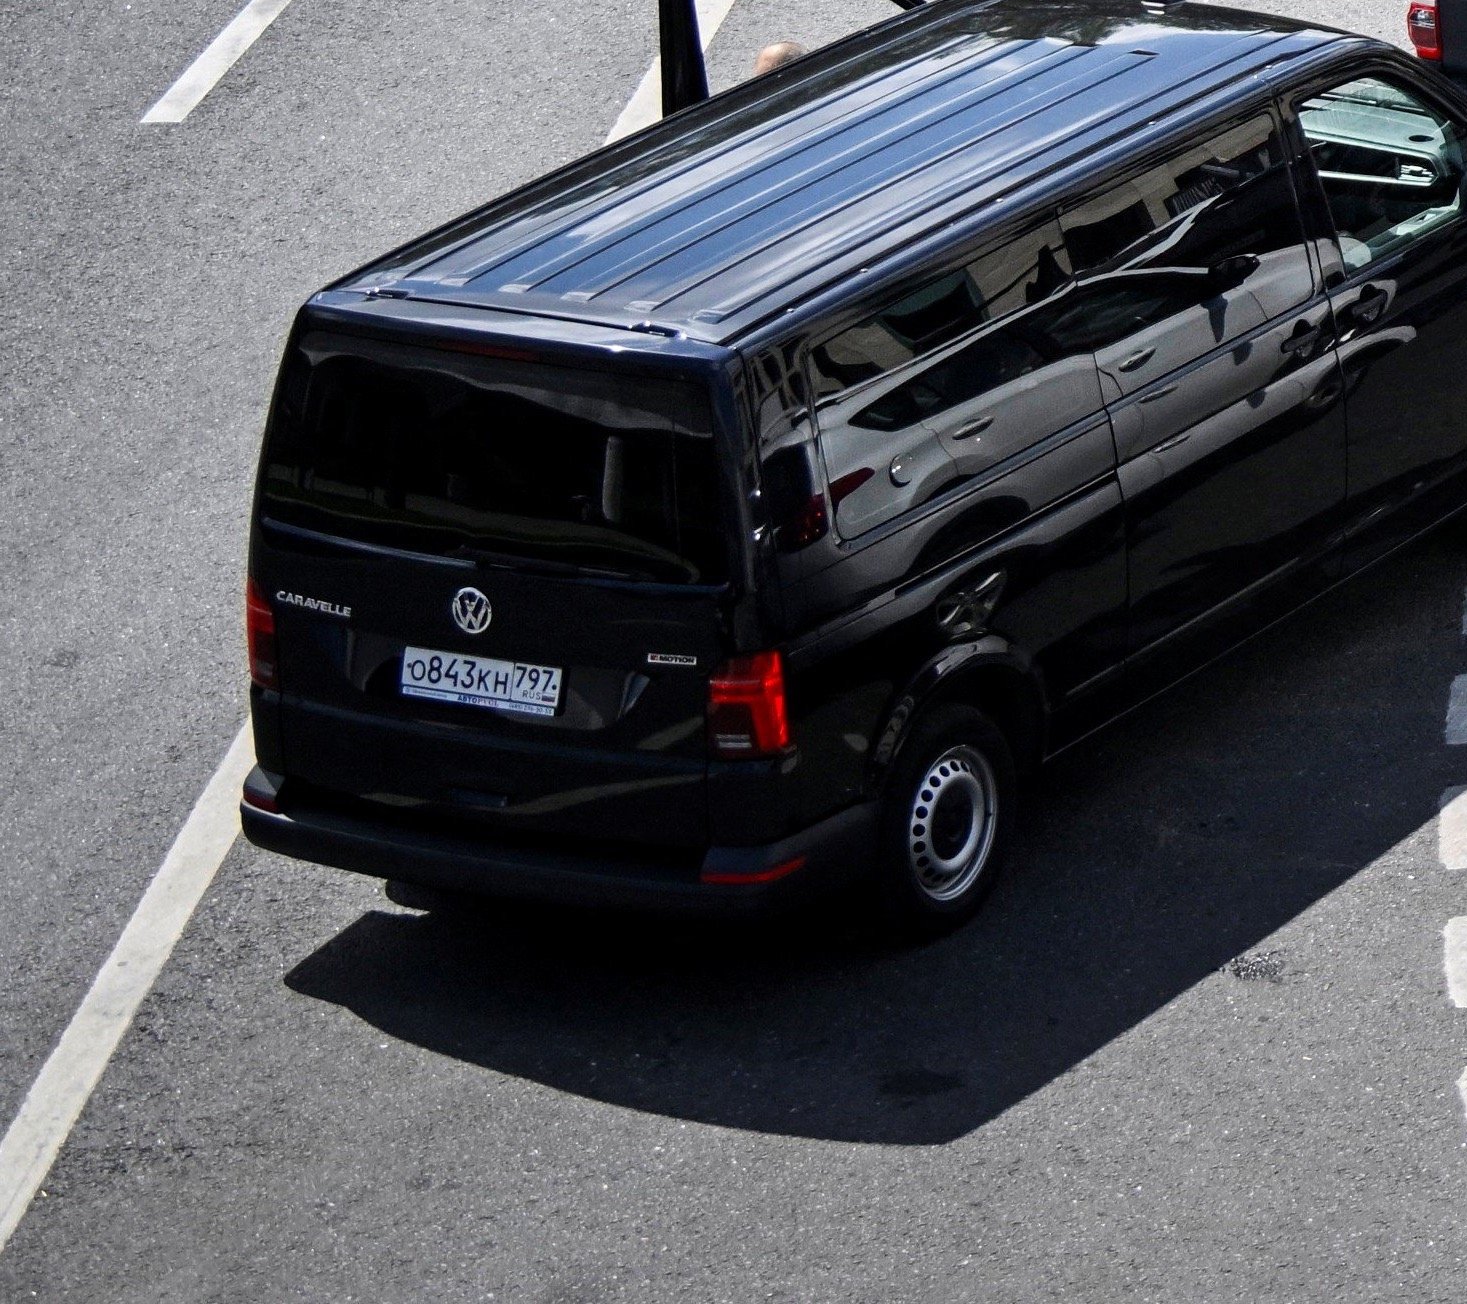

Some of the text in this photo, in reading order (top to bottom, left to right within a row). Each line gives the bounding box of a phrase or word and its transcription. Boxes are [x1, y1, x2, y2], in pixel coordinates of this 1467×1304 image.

[275, 590, 353, 619] CARAVELLE
[409, 658, 551, 694] О843КН 797
[522, 690, 541, 700] RUS
